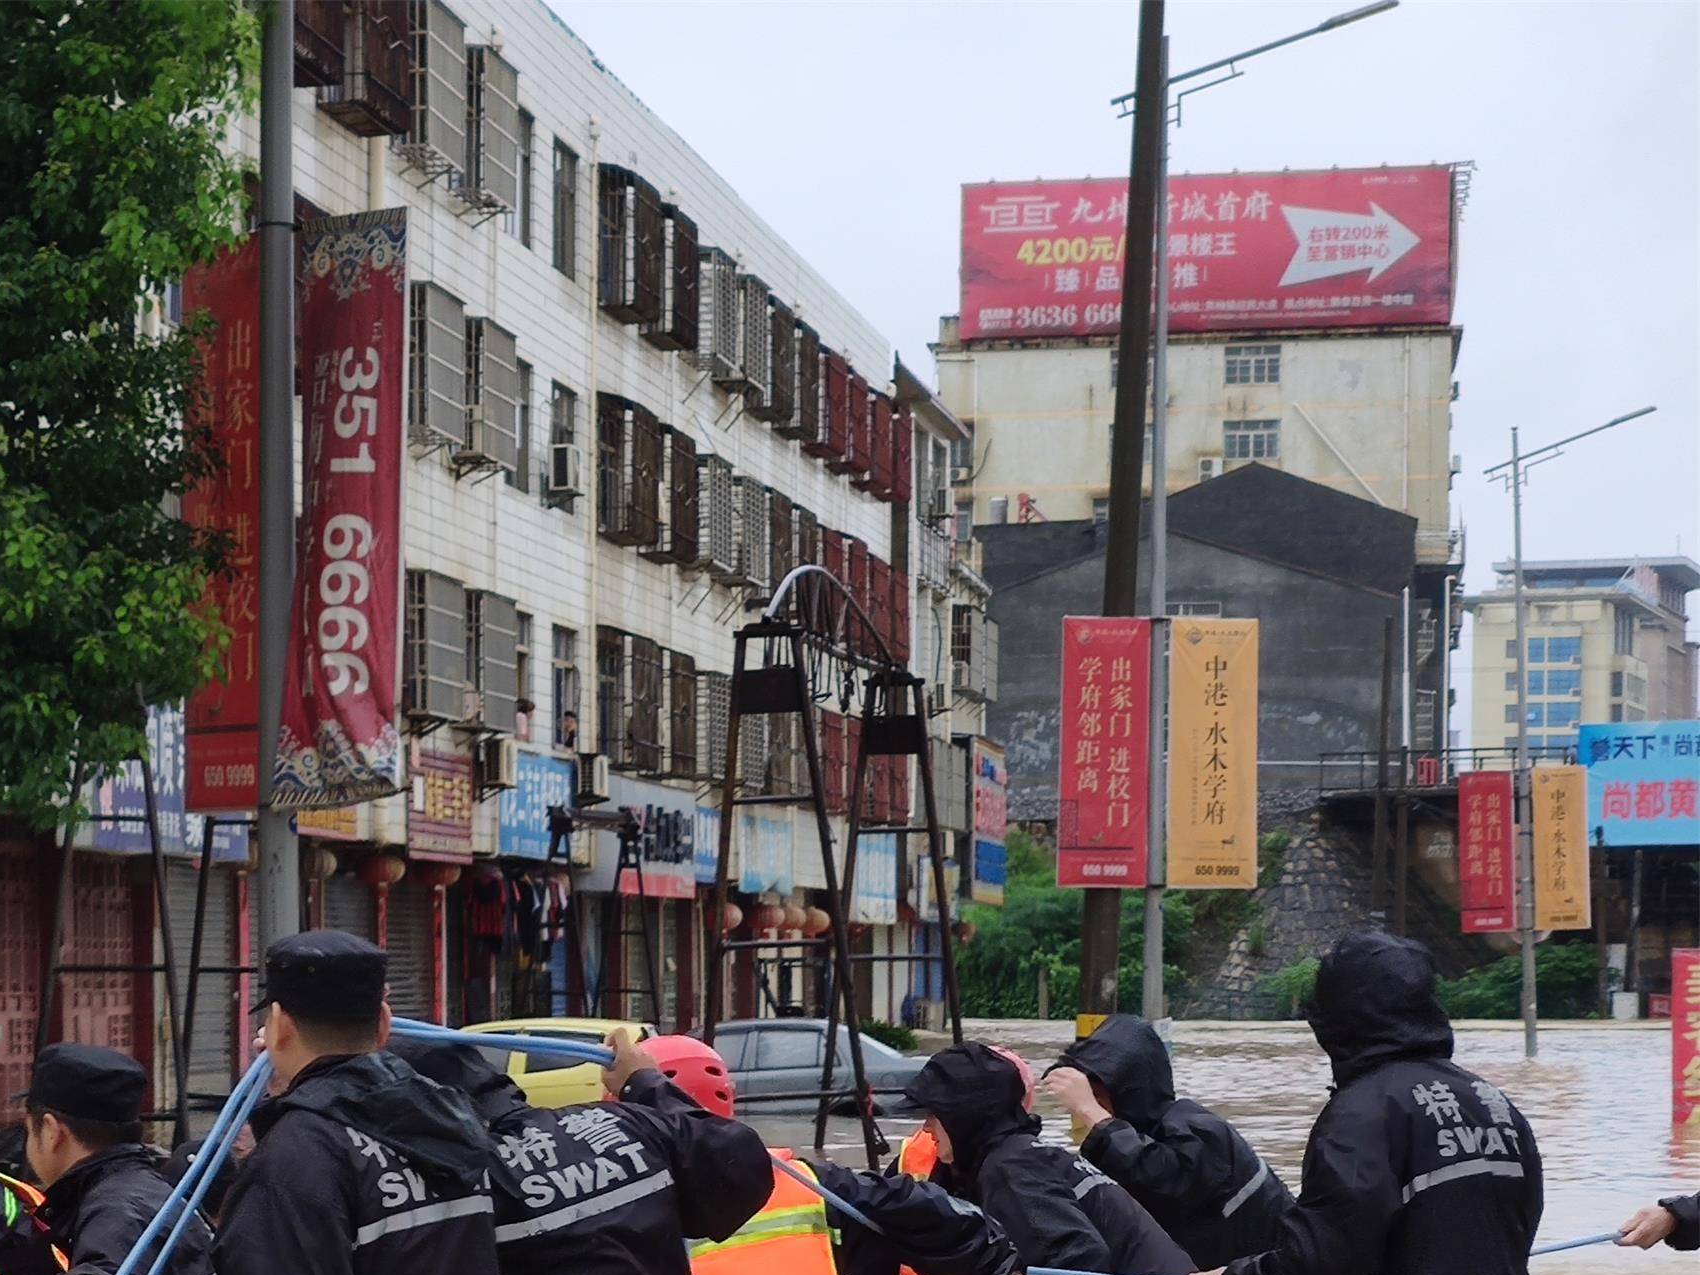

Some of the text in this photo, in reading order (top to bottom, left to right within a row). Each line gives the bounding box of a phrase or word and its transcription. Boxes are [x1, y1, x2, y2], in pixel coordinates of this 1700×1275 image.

[1308, 223, 1390, 243] 右转200米
[1016, 306, 1077, 329] 3636
[329, 346, 380, 473] 351
[317, 513, 373, 696] 6666
[1074, 655, 1103, 794] 学府邻距离
[1107, 655, 1133, 738] 出家门
[1202, 654, 1229, 826] 中港·水木学府
[1106, 747, 1132, 828] 进校门
[1102, 863, 1128, 877] 9999
[1195, 864, 1240, 877] 650 9999
[498, 1107, 631, 1173] 特警
[1437, 1126, 1522, 1159] SWAT
[519, 1141, 652, 1209] SWAT
